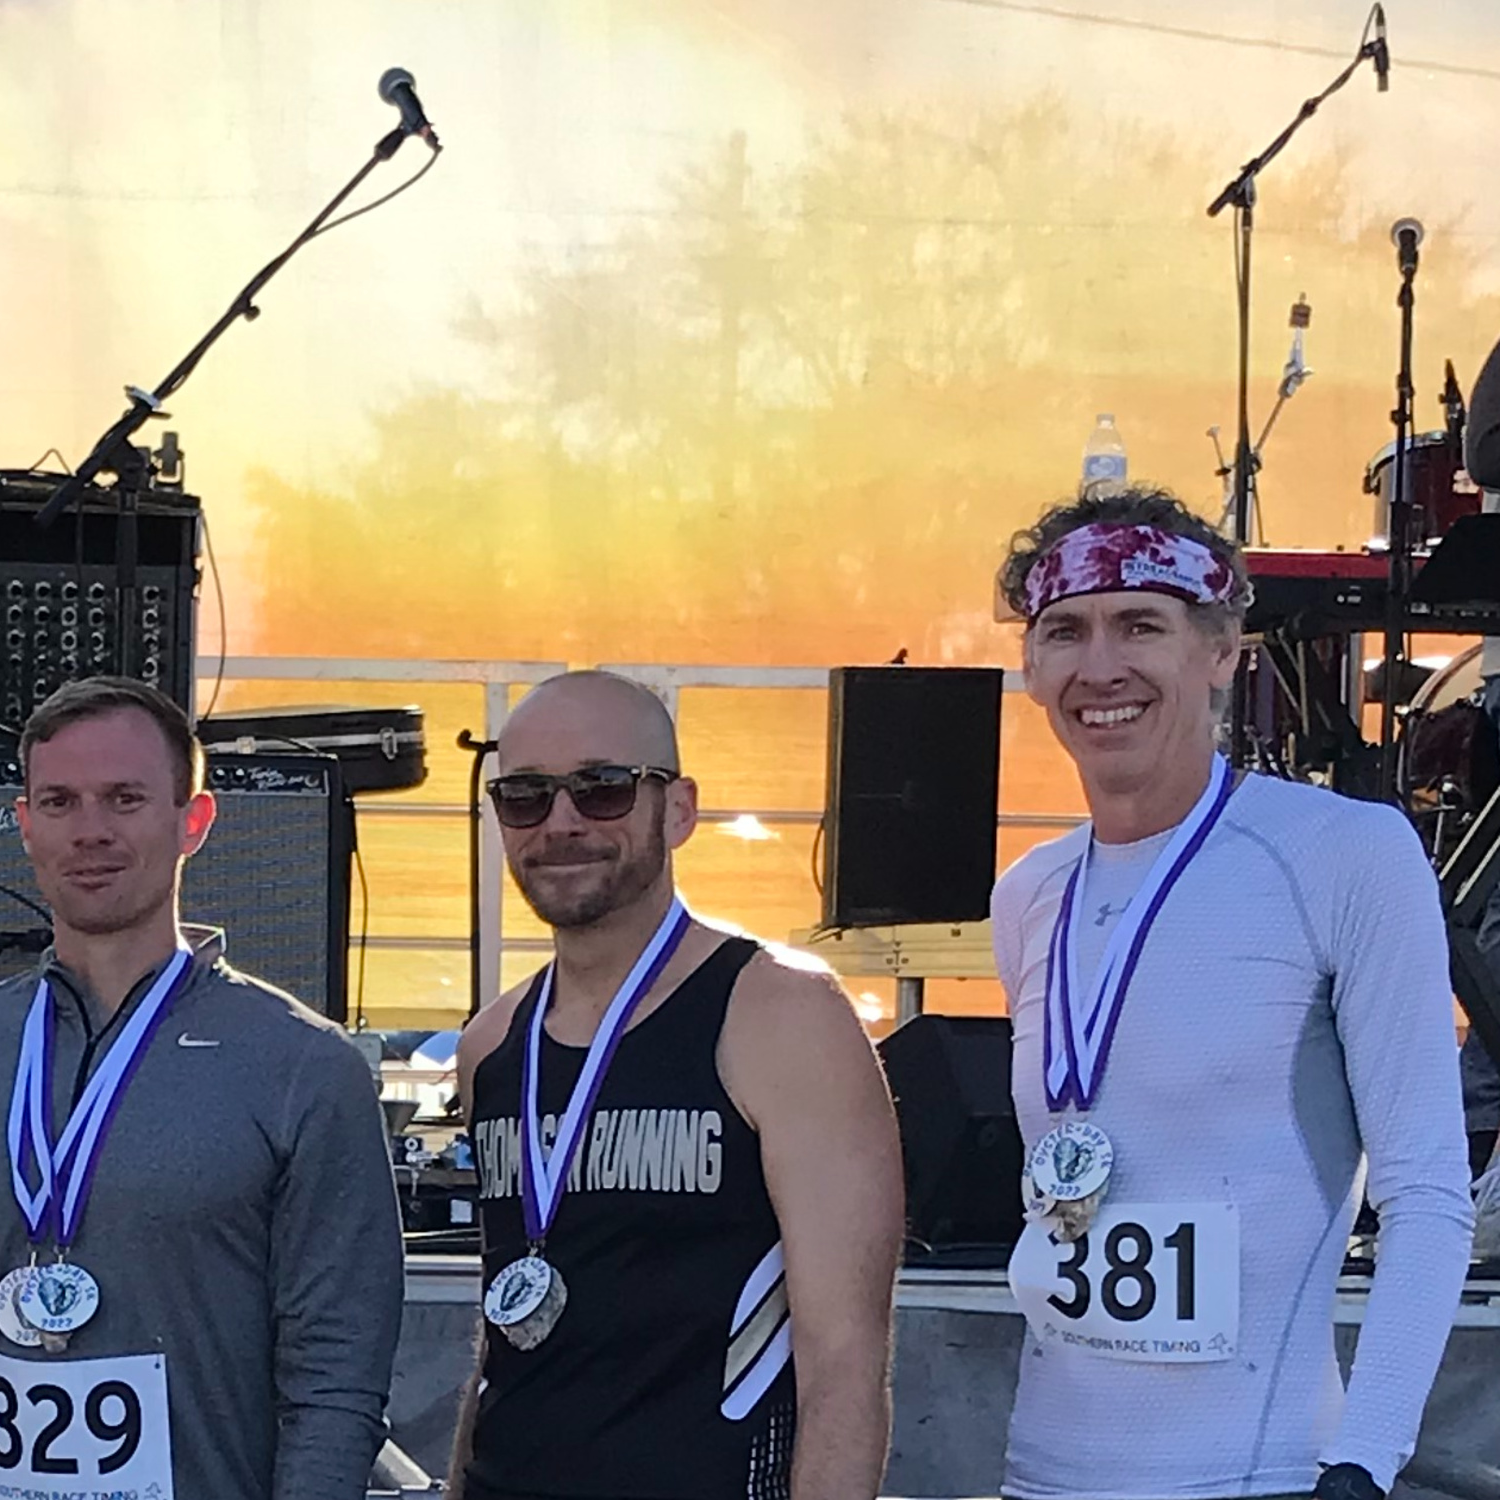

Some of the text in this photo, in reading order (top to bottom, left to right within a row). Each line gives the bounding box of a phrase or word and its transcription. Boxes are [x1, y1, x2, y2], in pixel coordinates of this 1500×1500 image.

[475, 1109, 723, 1199] THOMSN RUNNING
[1046, 1222, 1195, 1322] 381
[1115, 1339, 1148, 1353] RACE
[1152, 1339, 1201, 1353] TIMING
